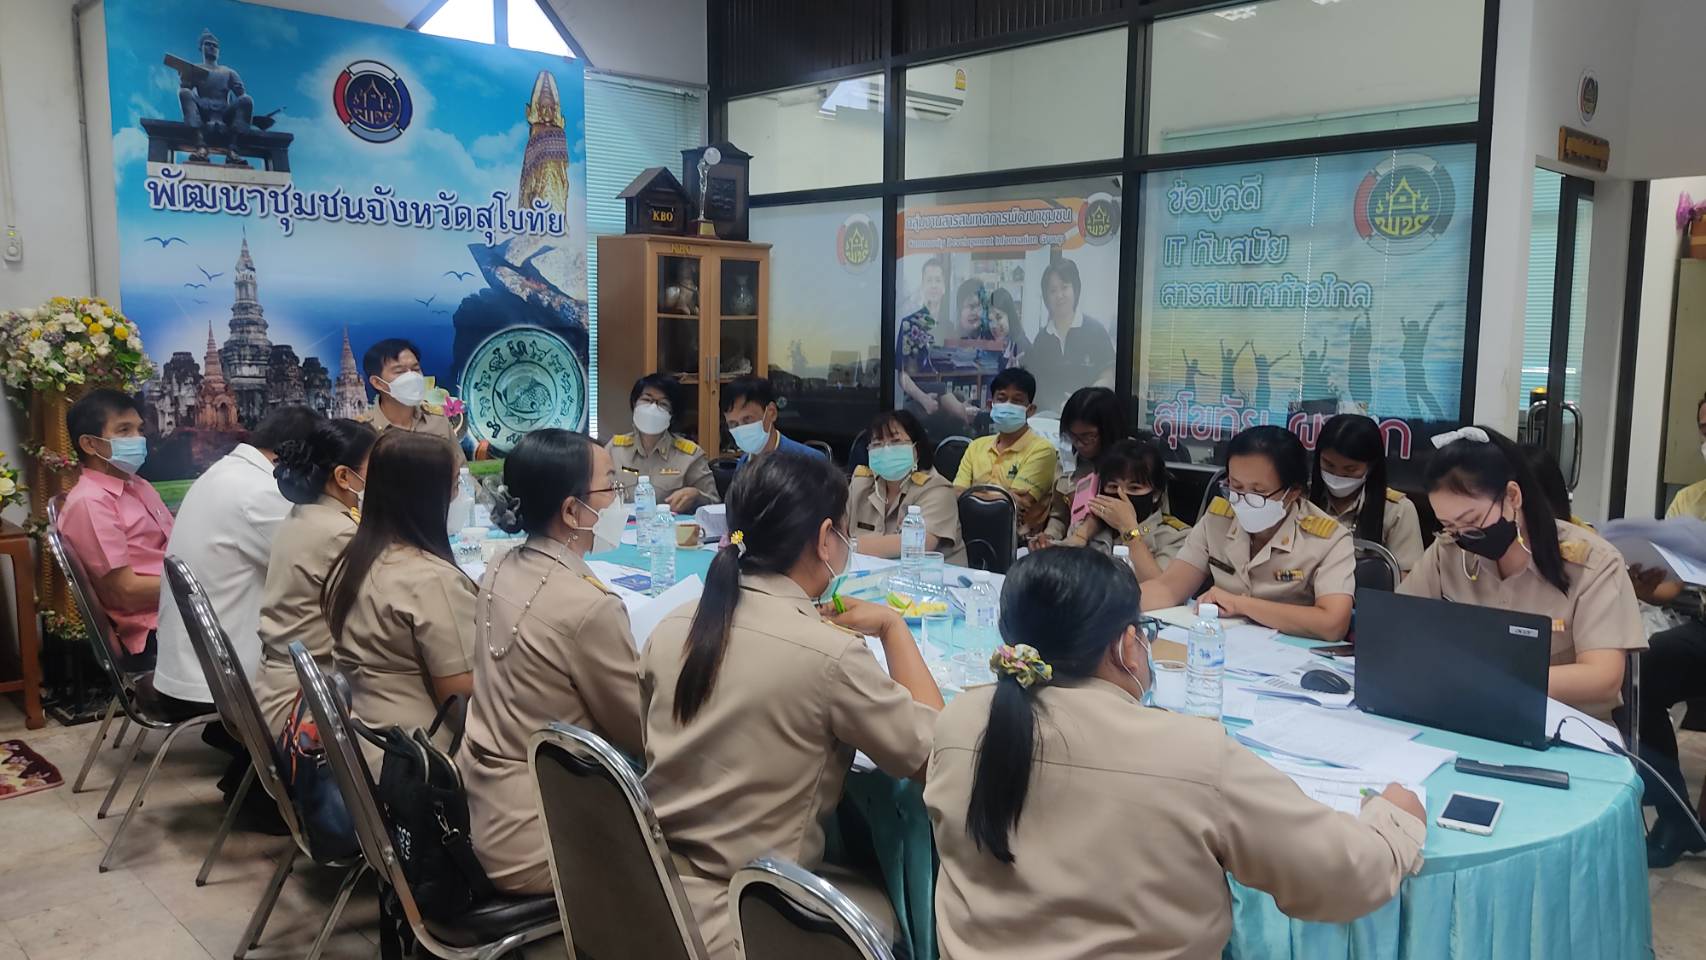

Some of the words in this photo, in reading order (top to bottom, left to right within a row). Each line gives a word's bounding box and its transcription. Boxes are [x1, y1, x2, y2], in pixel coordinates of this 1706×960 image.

[146, 166, 566, 246] พัฒนาชุมชนจังหวัดสุโขทัย
[652, 210, 673, 222] KBO
[1167, 174, 1262, 222] ข้อมูลดี
[1164, 235, 1187, 266] IT
[1192, 228, 1289, 265] ทันสมัย
[1161, 271, 1373, 308] สารสนเทศก้าวไกล
